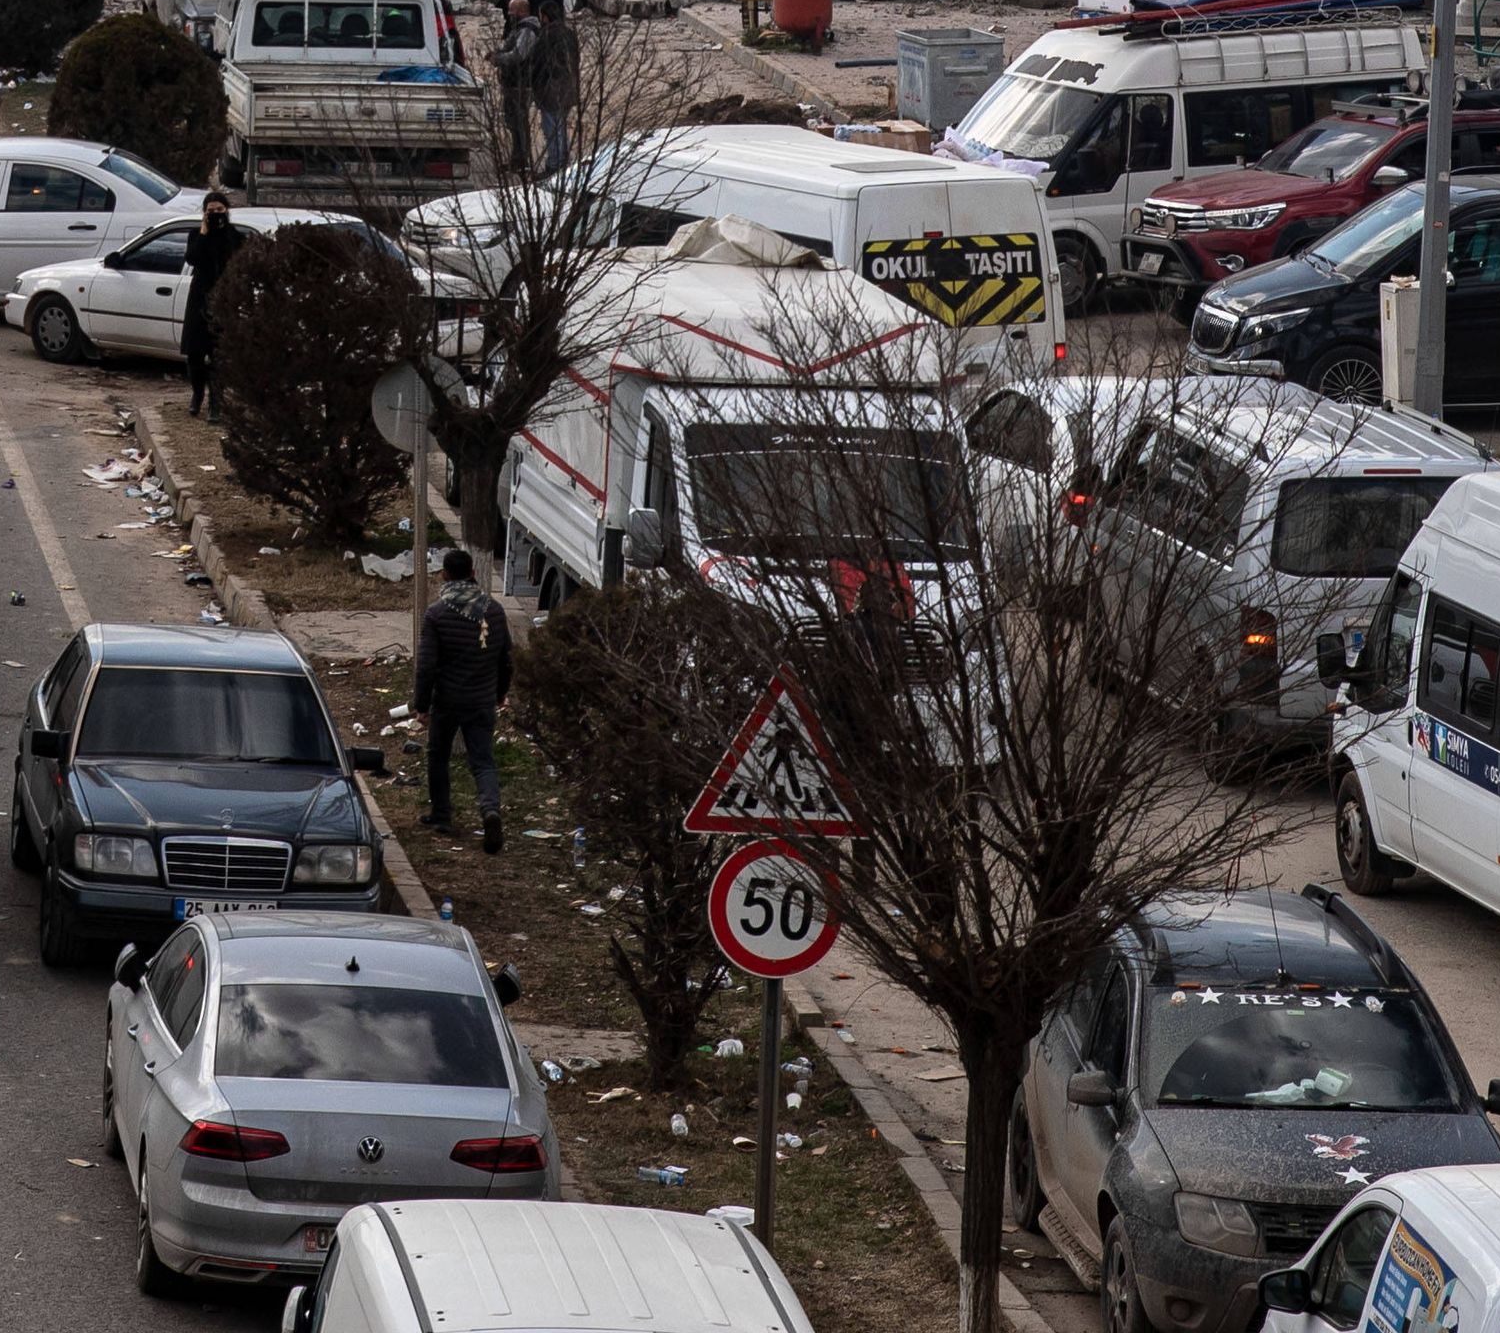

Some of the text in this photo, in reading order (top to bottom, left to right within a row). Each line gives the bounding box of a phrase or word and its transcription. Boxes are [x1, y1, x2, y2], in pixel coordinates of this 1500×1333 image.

[871, 250, 1033, 280] OKUL TAŞITI
[1447, 730, 1469, 759] SİMYA
[740, 877, 814, 941] 50
